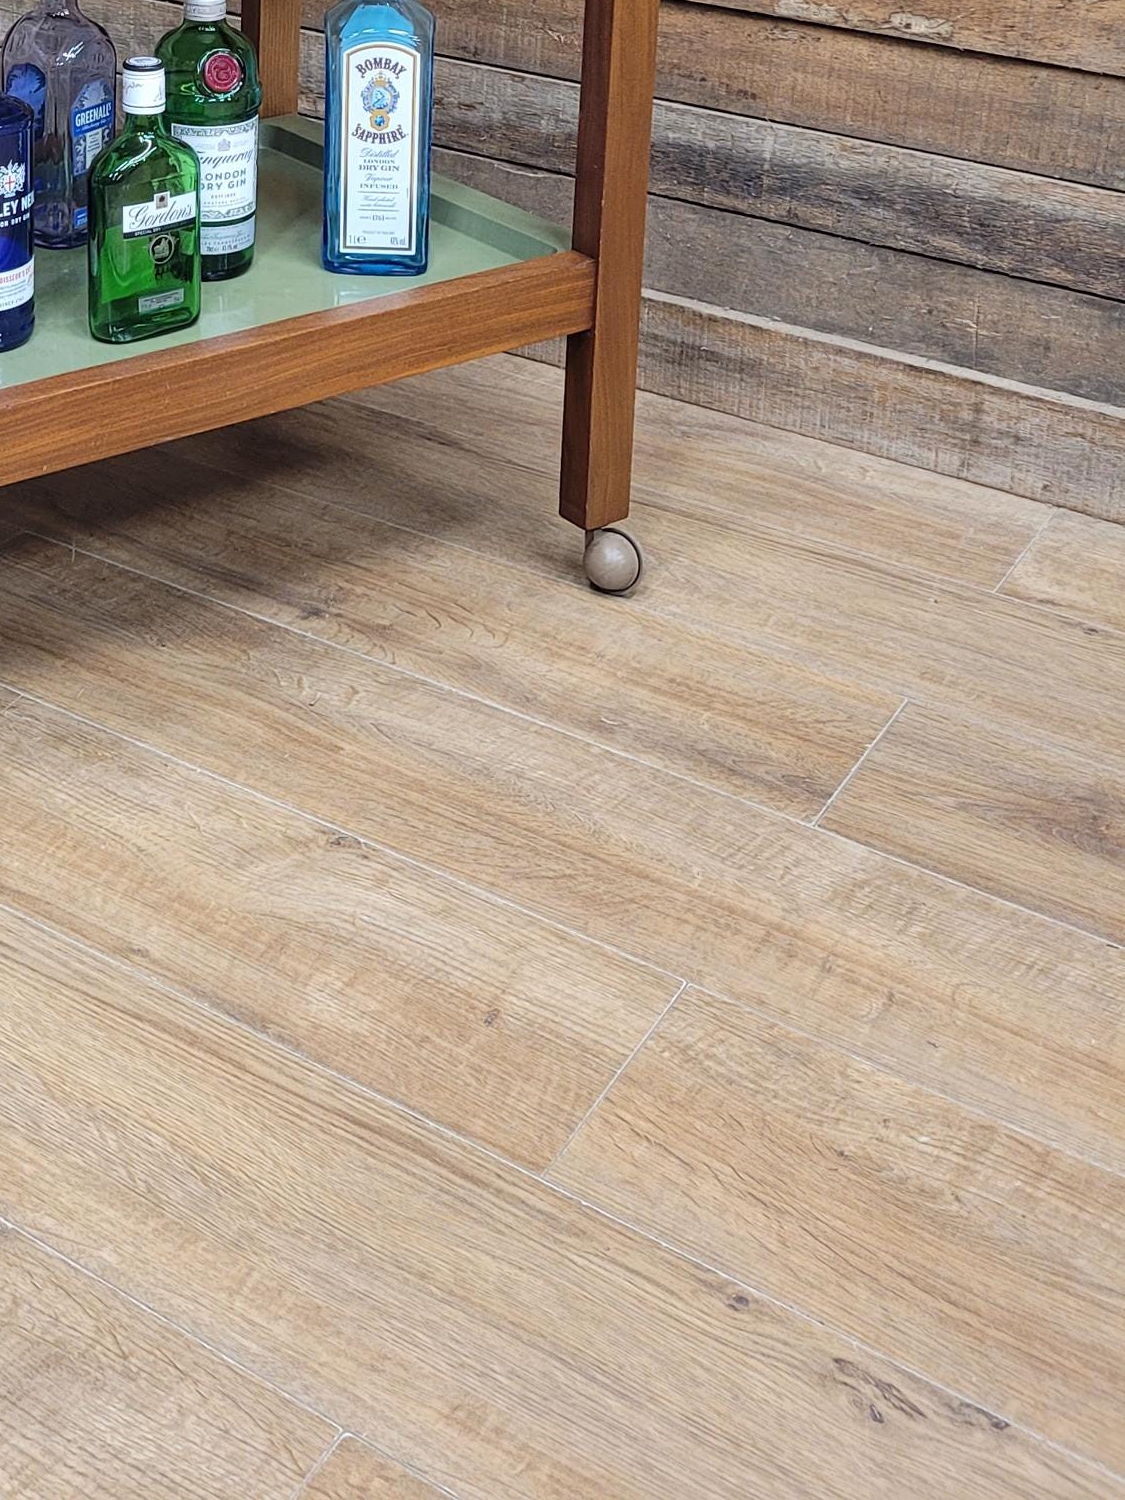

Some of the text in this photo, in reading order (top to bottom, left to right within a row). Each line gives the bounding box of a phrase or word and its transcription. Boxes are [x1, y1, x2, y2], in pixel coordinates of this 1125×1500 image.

[355, 57, 407, 79] BOMBAY
[75, 102, 113, 128] GREENALL'S
[351, 123, 407, 145] SAPPHIRE
[200, 168, 247, 181] ONDON
[228, 177, 247, 189] GIN
[128, 200, 193, 230] Gordon's
